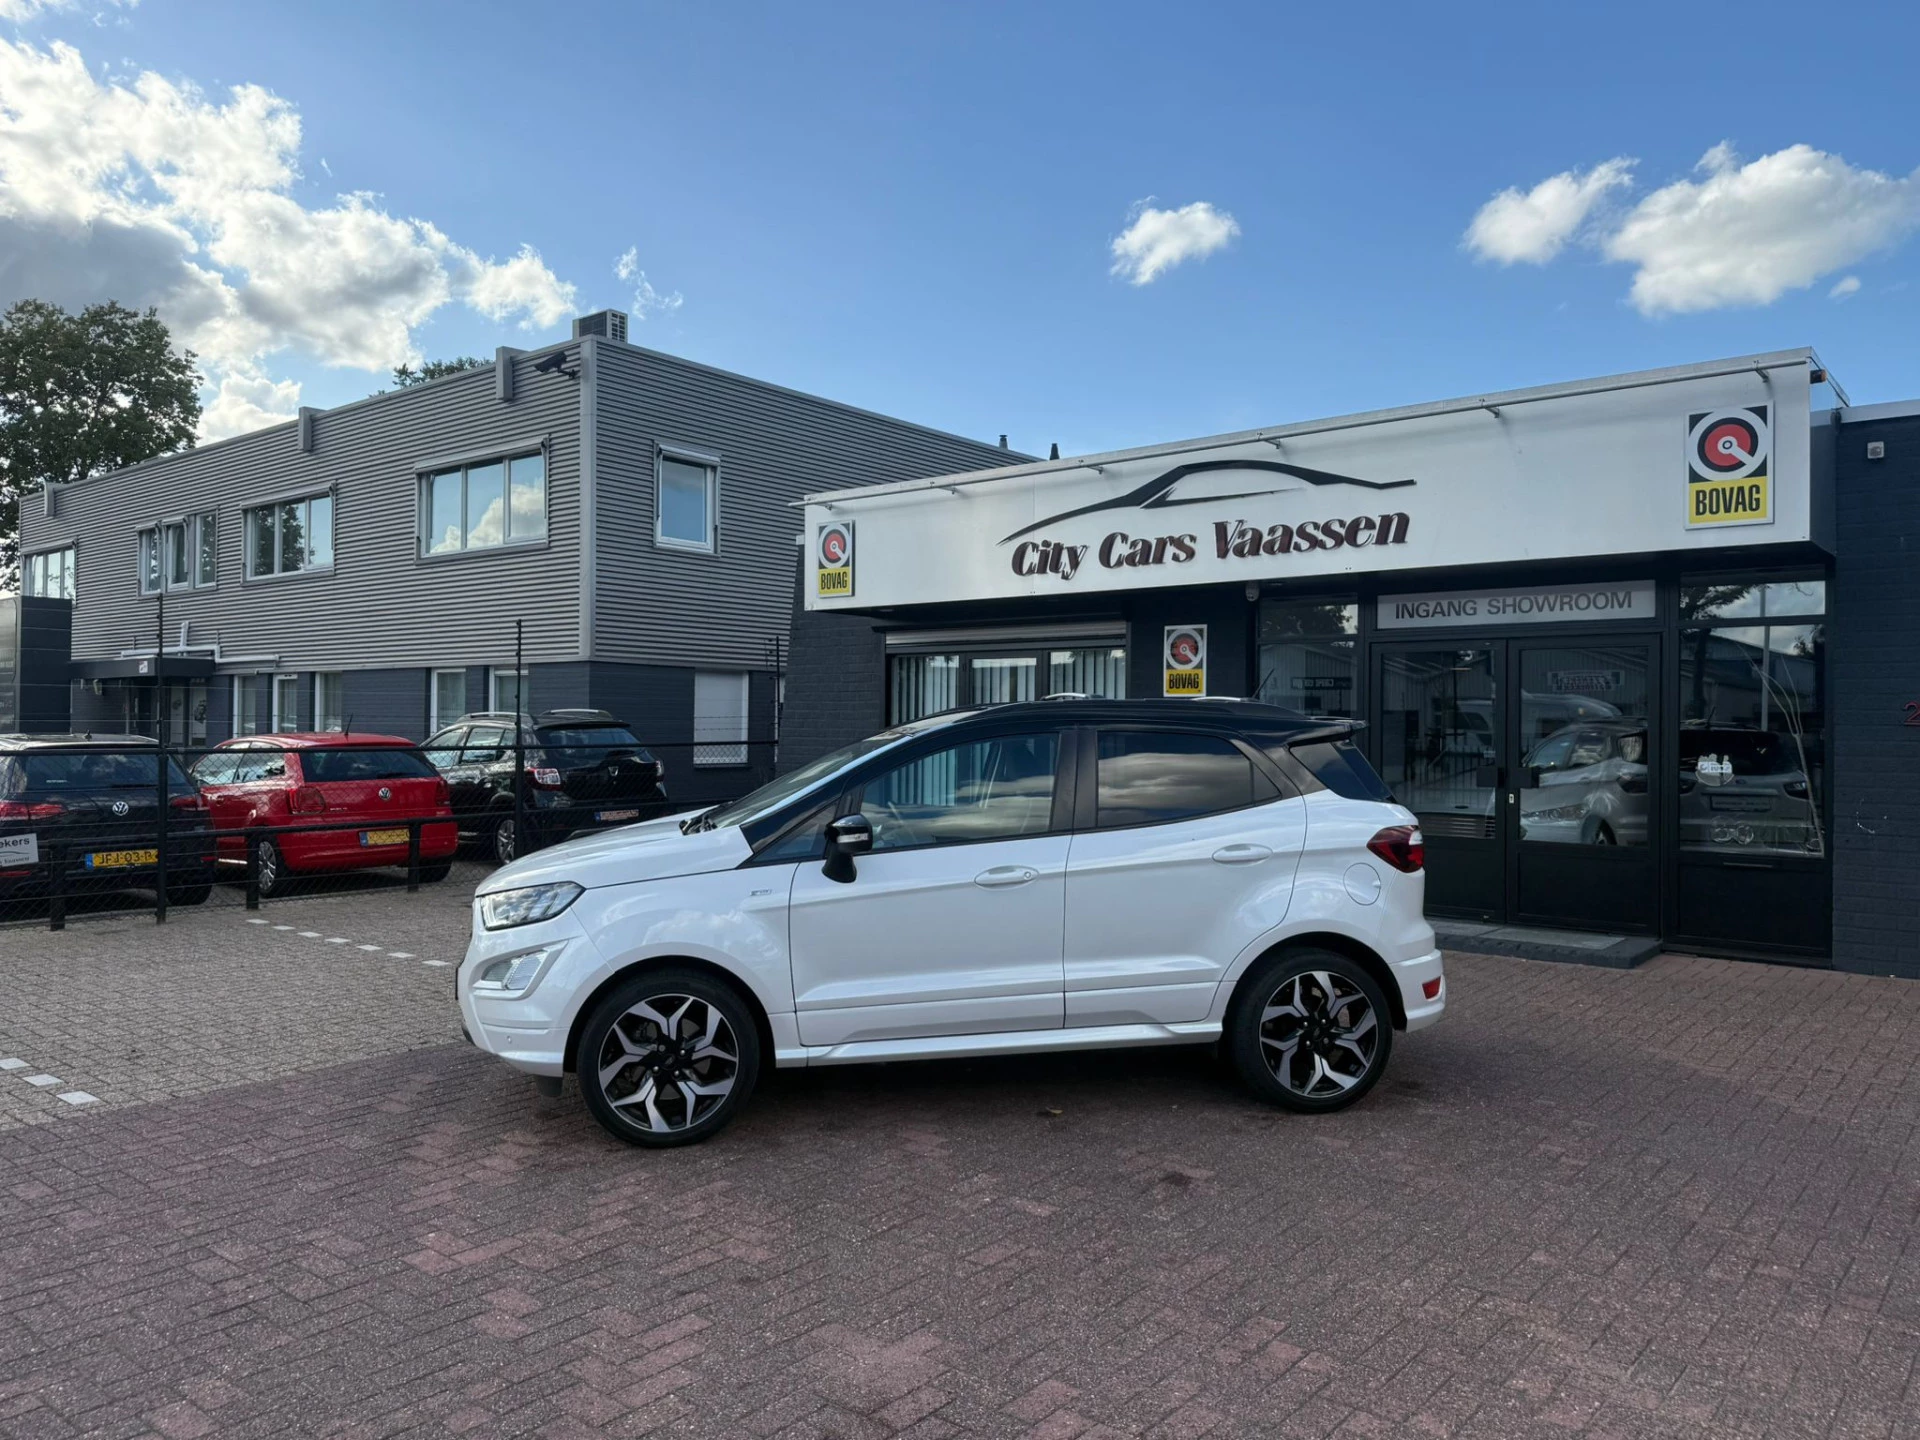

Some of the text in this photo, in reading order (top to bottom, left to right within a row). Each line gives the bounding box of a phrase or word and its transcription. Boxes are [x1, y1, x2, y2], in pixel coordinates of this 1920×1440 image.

[1695, 484, 1761, 516] BOVAG
[1011, 512, 1411, 580] City Cars Vaassen
[820, 571, 848, 590] BOVAG
[1395, 591, 1632, 619] INGANG SHOWROOM
[1168, 673, 1199, 690] BOVAG
